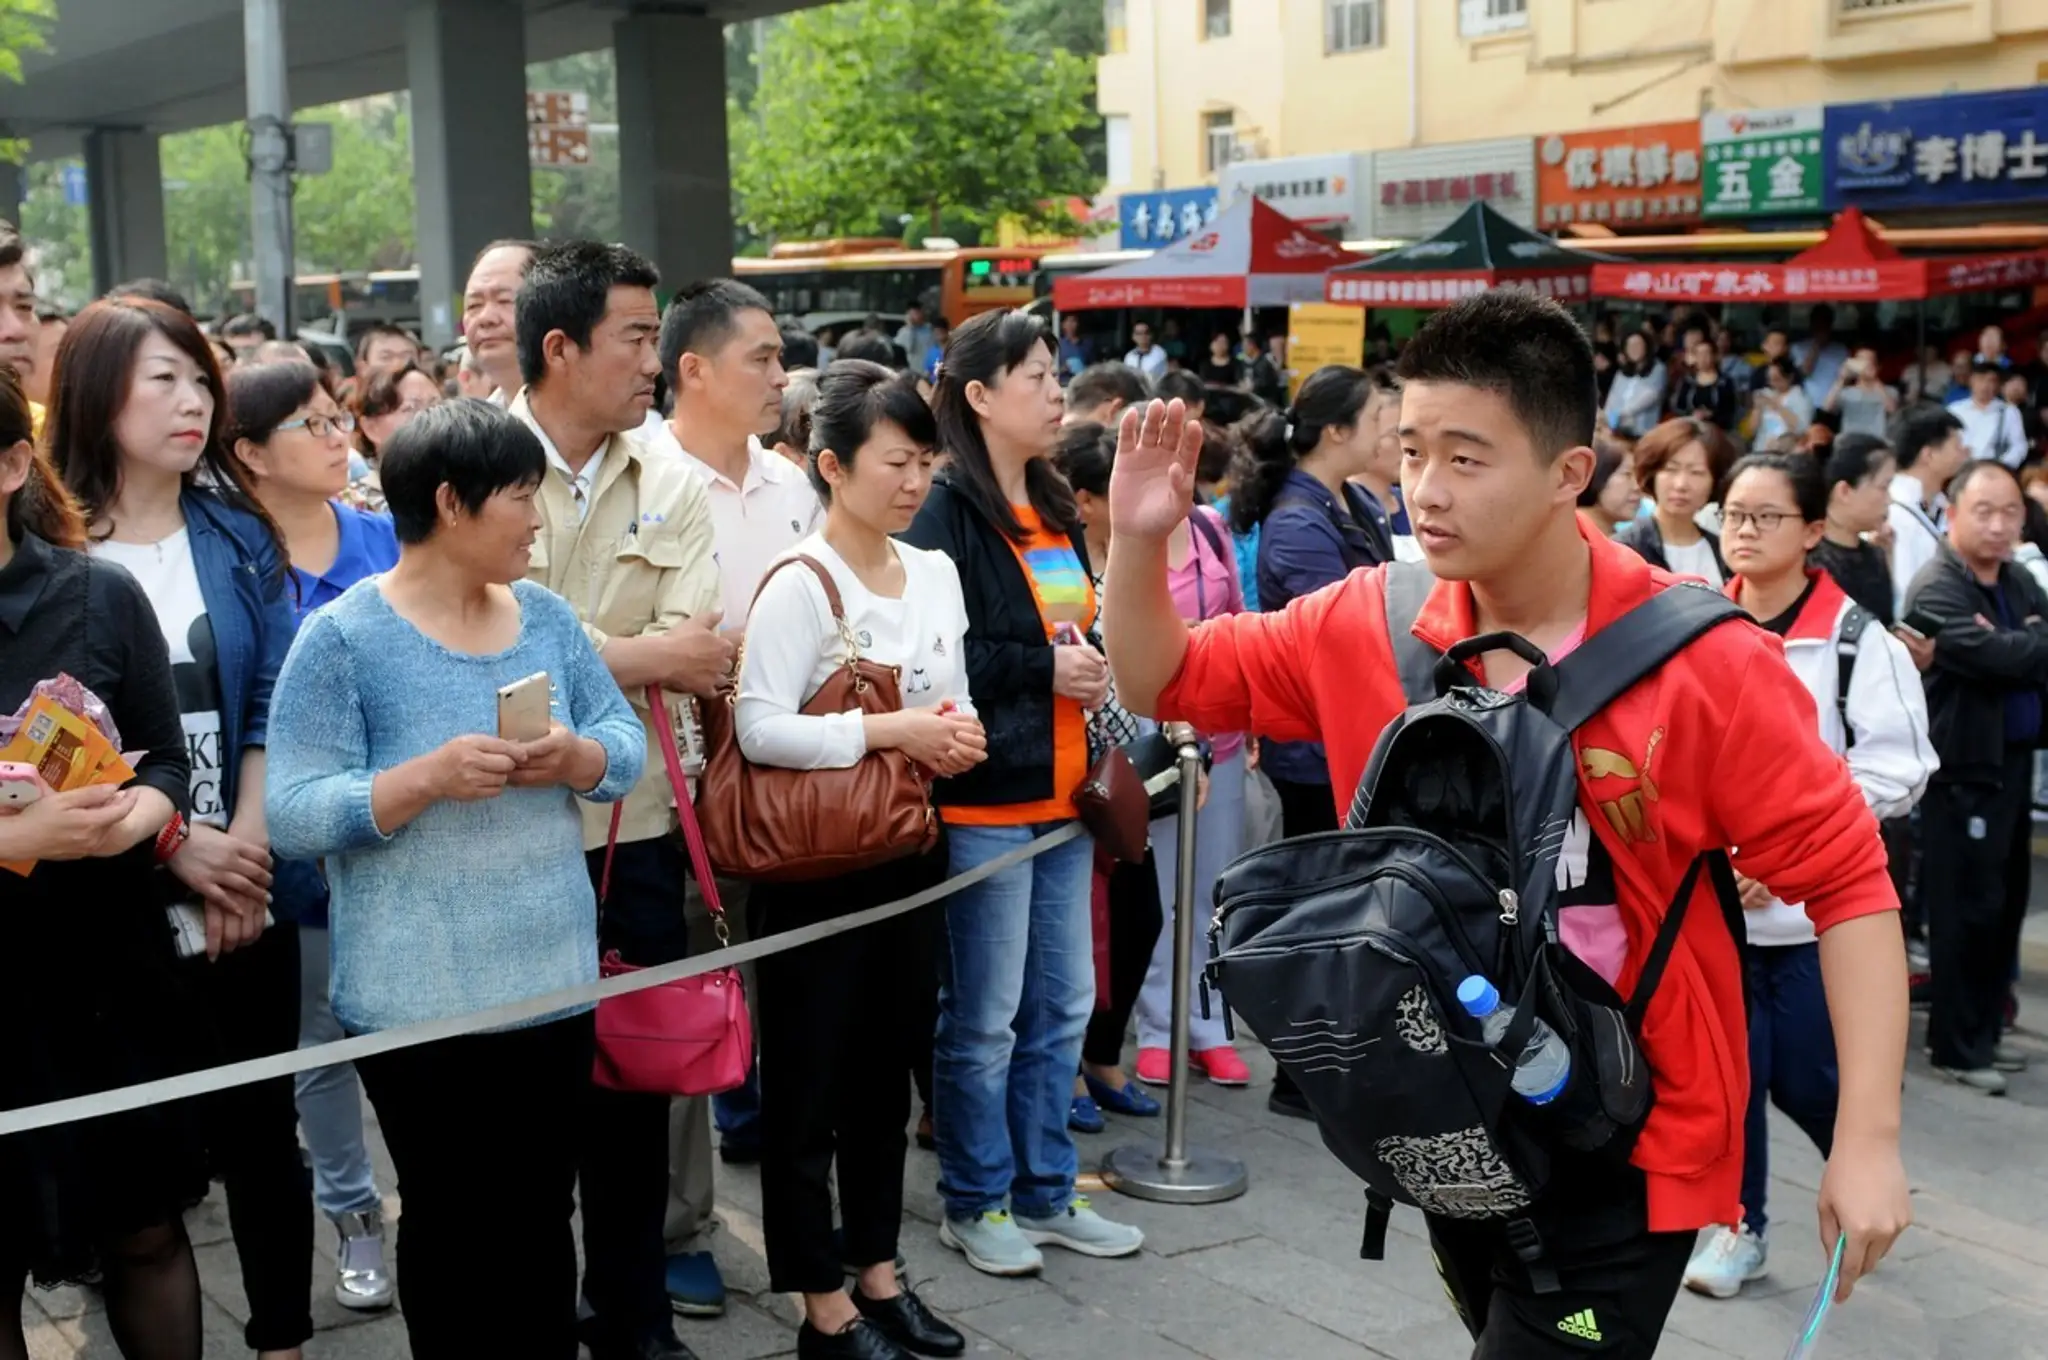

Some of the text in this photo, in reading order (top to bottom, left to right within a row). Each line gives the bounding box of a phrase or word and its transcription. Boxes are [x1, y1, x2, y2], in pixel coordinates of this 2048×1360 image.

[1914, 131, 2047, 184] 李博士
[1716, 156, 1804, 201] 五金
[1624, 269, 1774, 297] 崂山矿泉水
[1557, 1320, 1602, 1341] adidas
